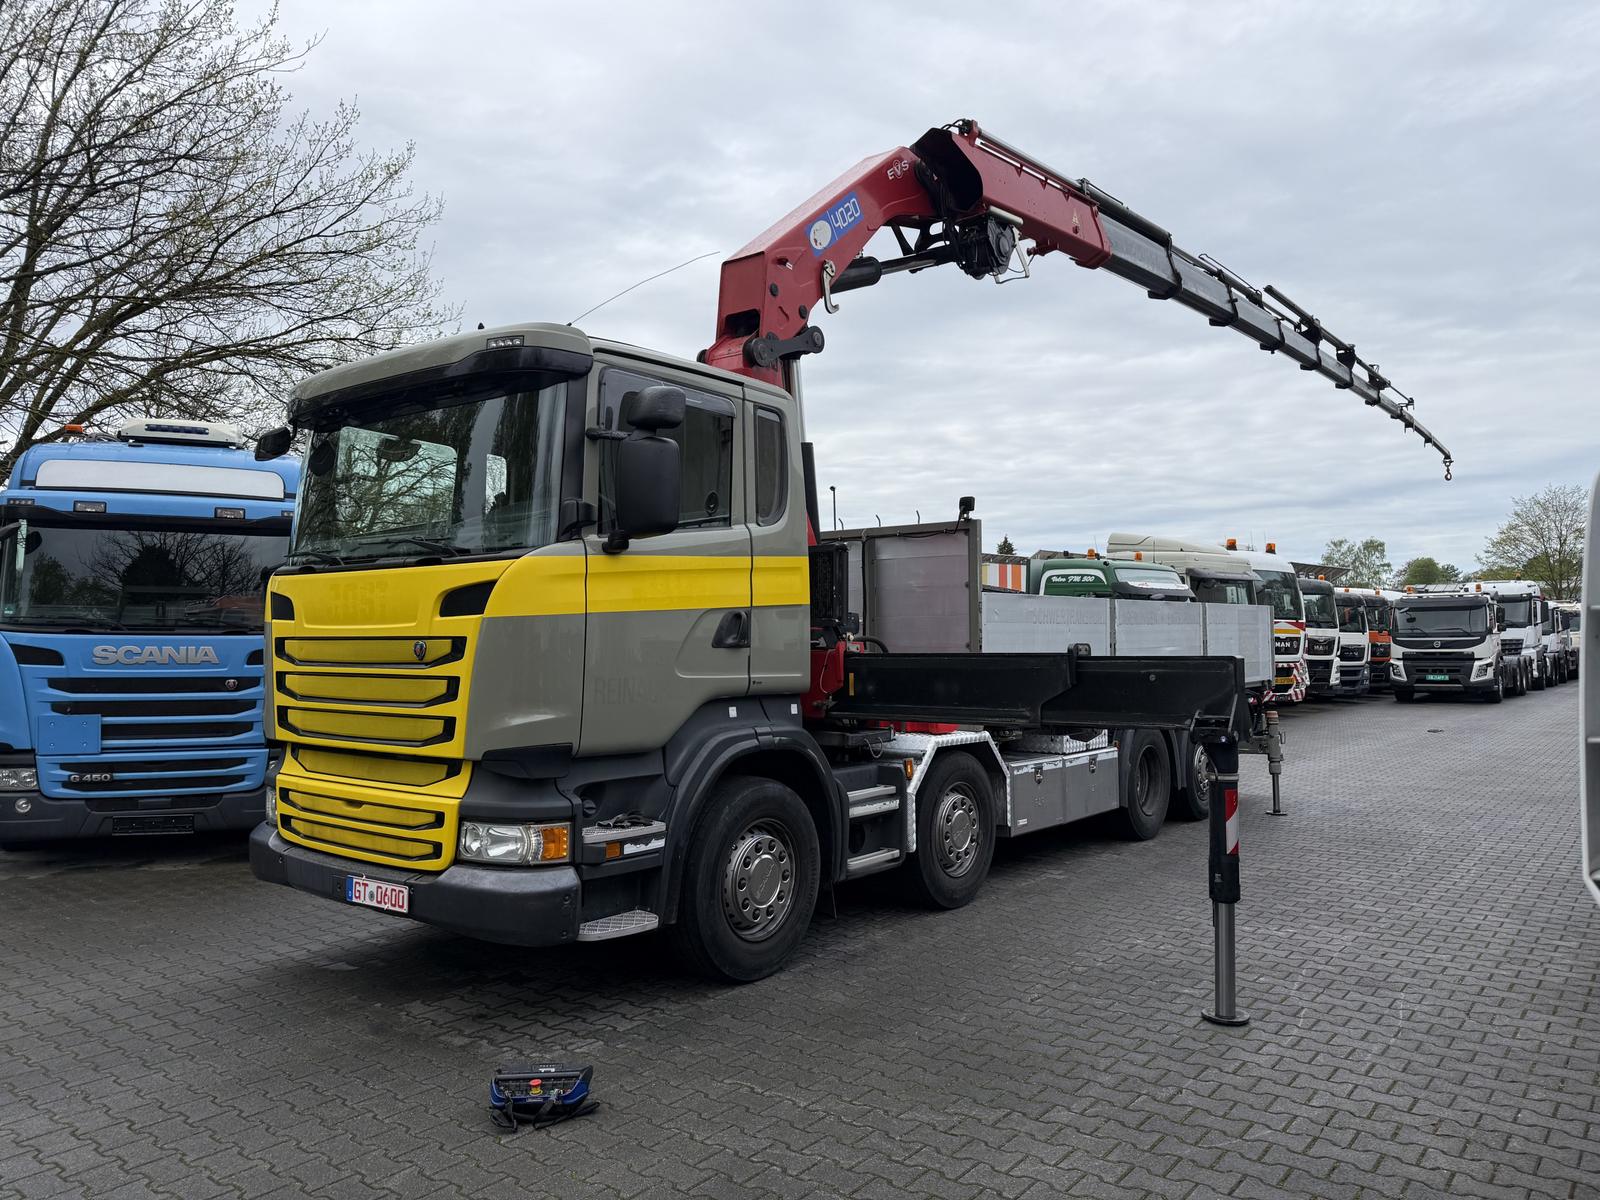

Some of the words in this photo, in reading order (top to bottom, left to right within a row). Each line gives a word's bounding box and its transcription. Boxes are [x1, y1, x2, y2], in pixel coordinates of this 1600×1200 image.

[887, 159, 909, 180] EVS
[831, 198, 860, 229] 4020
[92, 645, 220, 665] SCANIA
[70, 773, 80, 782] G
[82, 773, 111, 782] 450
[354, 881, 369, 902] GT
[375, 885, 405, 909] 0600
